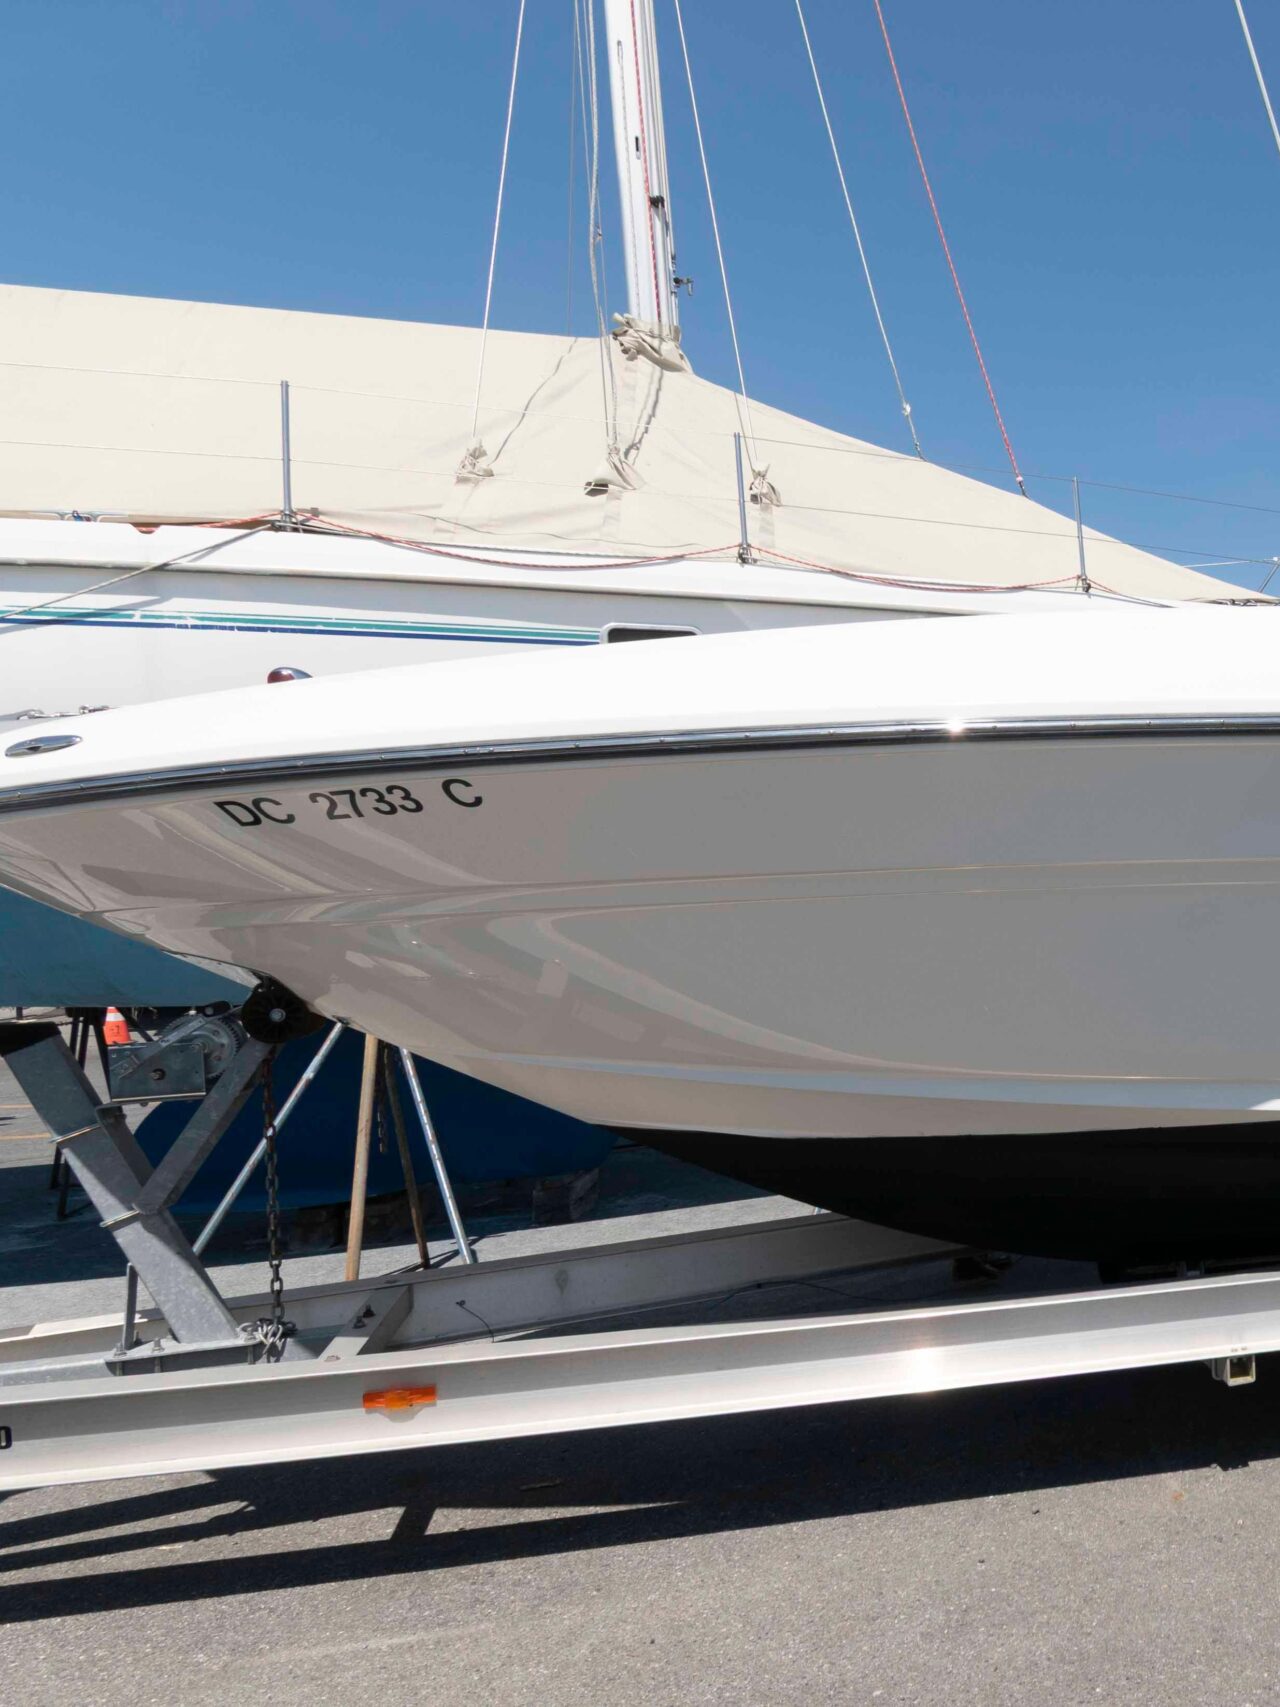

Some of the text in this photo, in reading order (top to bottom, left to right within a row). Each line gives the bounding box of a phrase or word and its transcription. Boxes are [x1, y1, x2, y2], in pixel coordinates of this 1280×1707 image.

[214, 778, 483, 827] DC 2733 C
